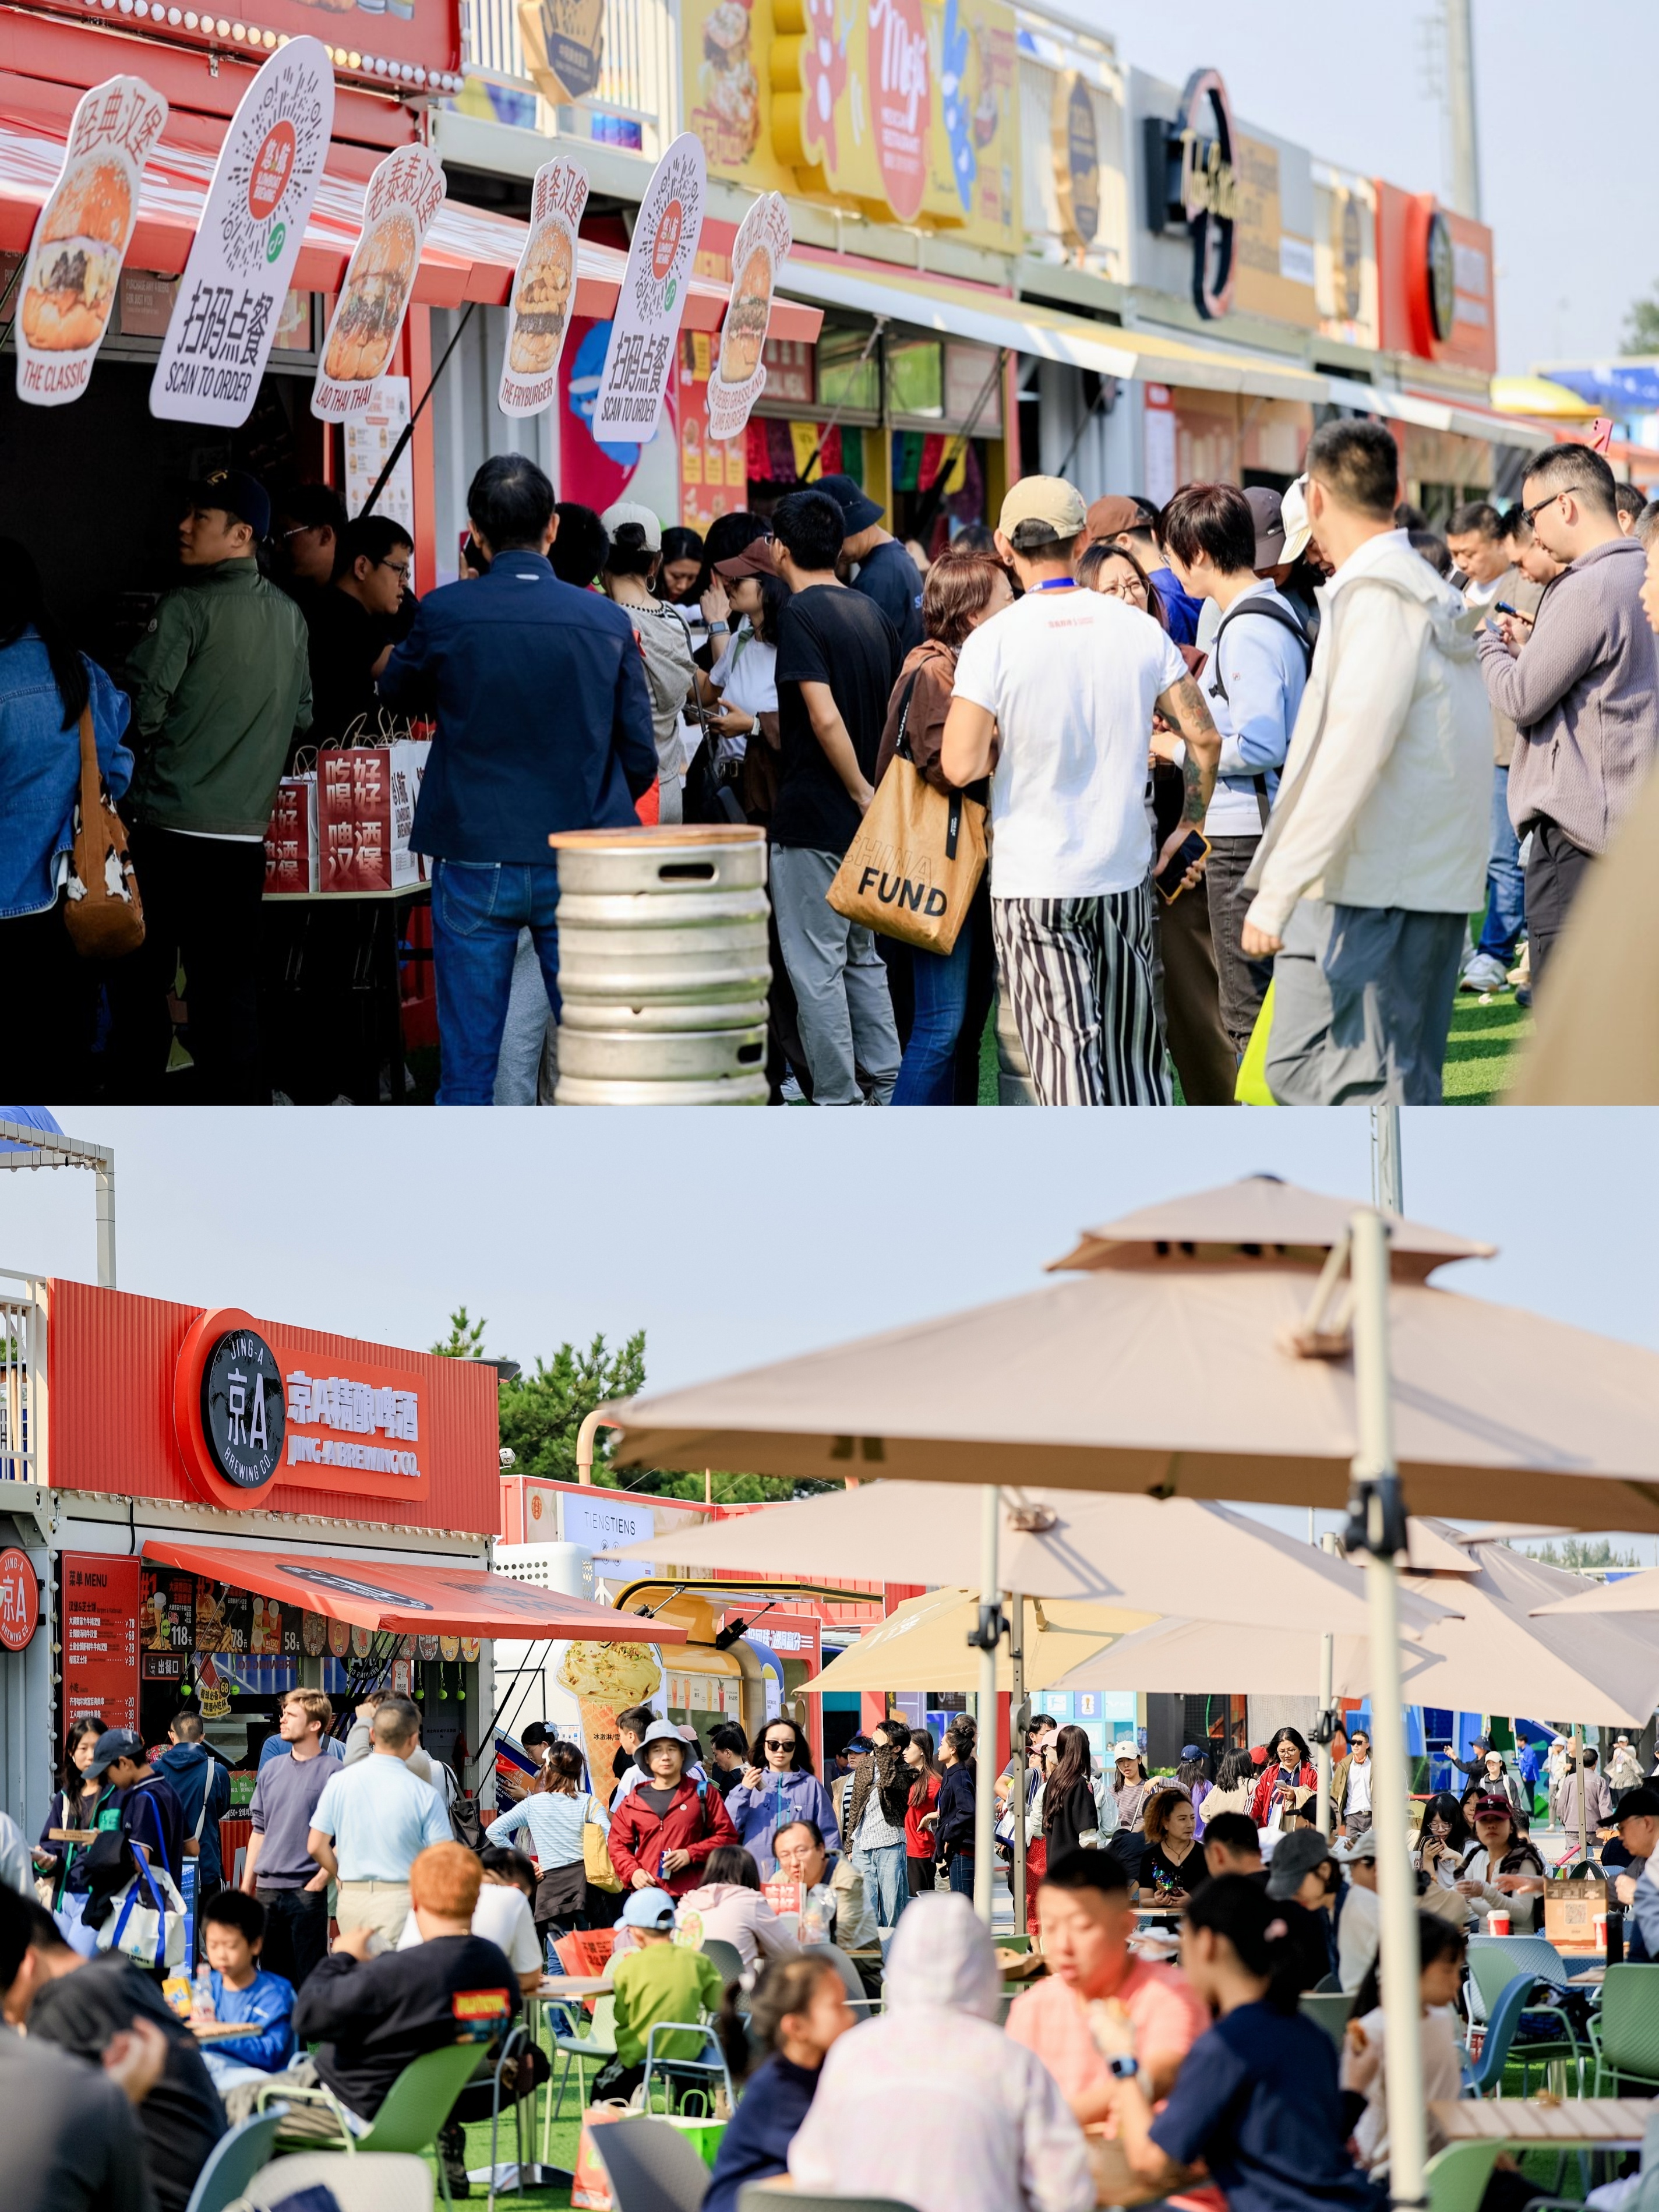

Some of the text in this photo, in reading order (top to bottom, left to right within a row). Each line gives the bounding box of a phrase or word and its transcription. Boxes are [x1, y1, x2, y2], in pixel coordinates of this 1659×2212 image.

[73, 87, 163, 166] 经典汉堡
[369, 153, 442, 232] 老泰泰汉堡
[535, 164, 587, 227] 薯条汉堡
[177, 279, 274, 367] 扫码点餐
[23, 359, 88, 393] THE CLASSIC
[609, 331, 670, 394] 扫码点餐
[165, 361, 252, 402] SCAN TO ORDER
[502, 377, 553, 407] THE FRYBURGER
[316, 382, 373, 411] LAO THAI THAI
[601, 396, 656, 422] SCAN TO ORDER
[325, 757, 381, 784] 吃好
[326, 782, 381, 814] 喝好
[329, 821, 382, 848] 啤酒
[845, 834, 932, 888] CHINA
[857, 866, 948, 917] FUND
[230, 1338, 264, 1366] JING-A
[227, 1367, 268, 1451] 京A
[286, 1370, 418, 1442] 京A精酿啤酒
[224, 1445, 274, 1482] BREWING CO.
[287, 1434, 421, 1477] JING-A BREWING CO.
[584, 1512, 636, 1536] TIENSTIENS
[5, 1557, 24, 1573] JING-A
[69, 1571, 107, 1587] 菜单 MENU
[3, 1575, 27, 1623] 京A
[1, 1622, 22, 1642] BREWING
[125, 1618, 135, 1628] ¥78
[125, 1631, 135, 1641] ¥68
[171, 1626, 192, 1646] 118元
[125, 1643, 135, 1653] ¥78
[231, 1629, 248, 1648] 78元
[284, 1632, 300, 1650] 58元
[125, 1656, 135, 1666] ¥38
[158, 1659, 179, 1674] 出餐口
[125, 1697, 135, 1707] ¥20
[200, 1688, 218, 1701] 看球必备
[204, 1699, 227, 1712] 啤酒小吃杯
[125, 1710, 135, 1720] ¥38
[513, 1775, 523, 1784] NOTE
[502, 1790, 512, 1800] EXCEED
